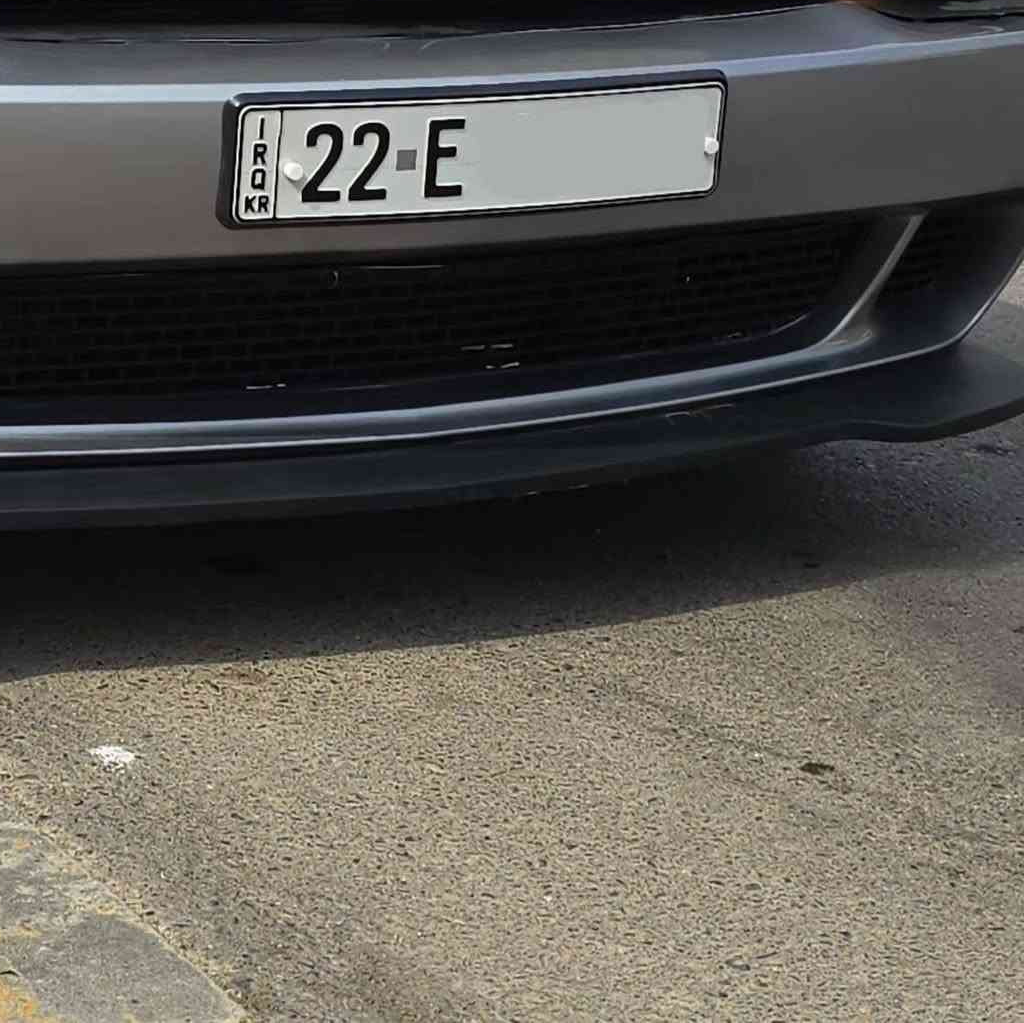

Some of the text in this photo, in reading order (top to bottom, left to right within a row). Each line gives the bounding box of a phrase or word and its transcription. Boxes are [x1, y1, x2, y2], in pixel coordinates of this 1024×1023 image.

[301, 118, 466, 204] 22 E
[243, 194, 270, 214] KR
